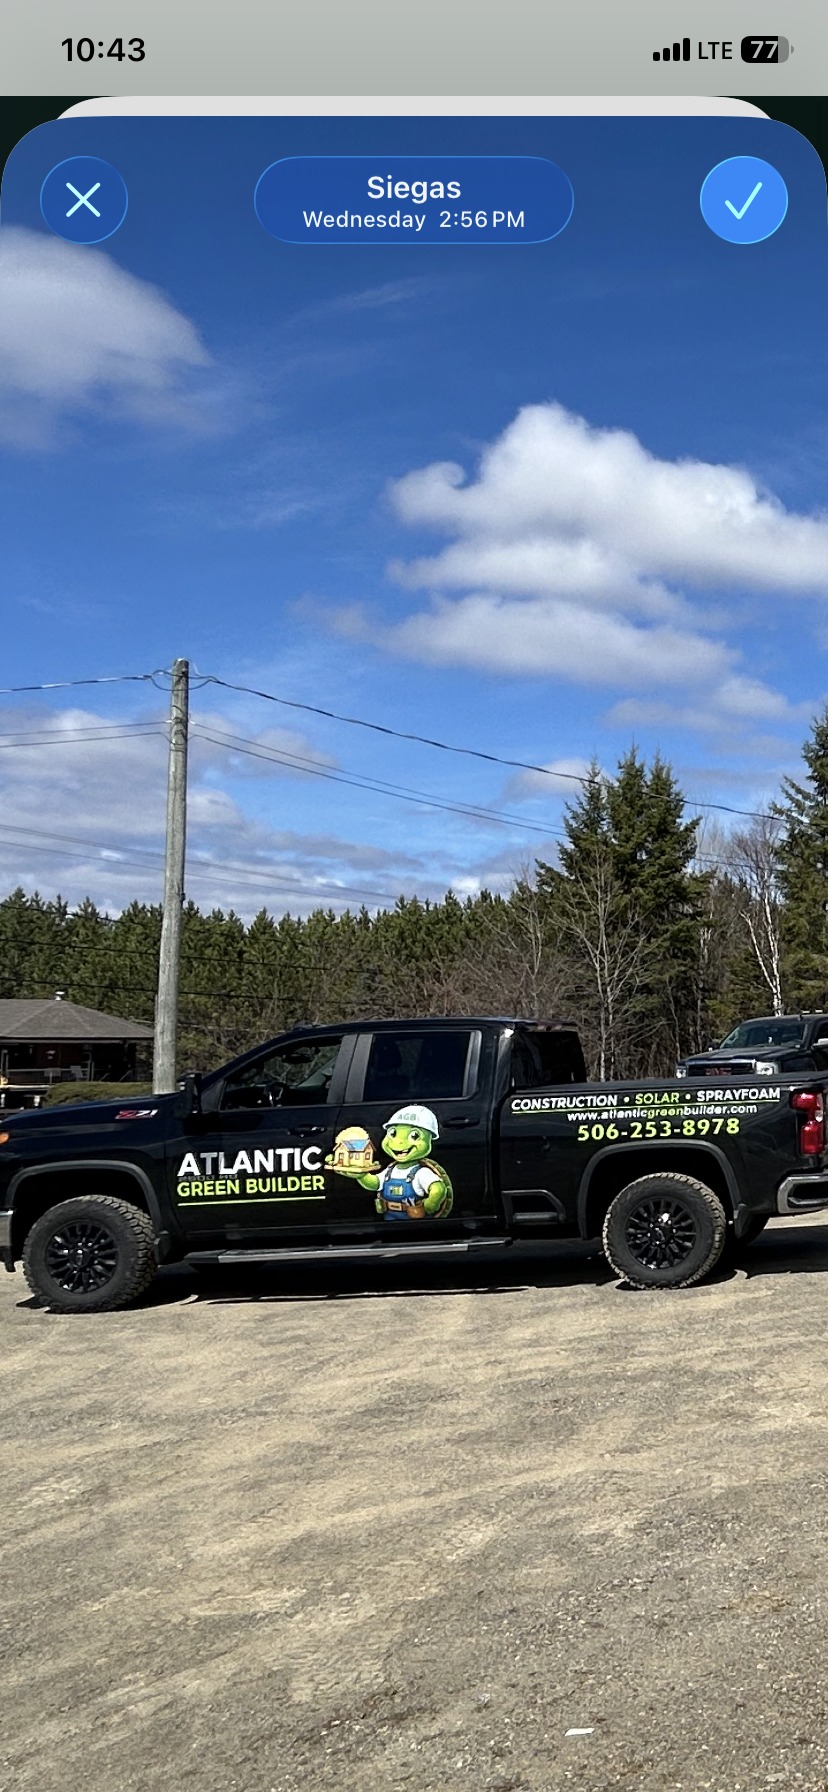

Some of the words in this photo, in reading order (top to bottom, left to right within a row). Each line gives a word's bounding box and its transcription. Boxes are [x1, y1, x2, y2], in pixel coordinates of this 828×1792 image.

[511, 1094, 618, 1110] CONSTRUCTION
[635, 1092, 680, 1105] SOLAR
[696, 1087, 781, 1102] SPRAYFOAM
[397, 1113, 417, 1121] AGB
[566, 1104, 758, 1121] www.atlanticgreenbuilder.com
[577, 1117, 740, 1141] 506-253-8978
[176, 1145, 323, 1177] ATLANTIC
[176, 1179, 240, 1197] GREEN
[245, 1174, 325, 1194] BUILDER
